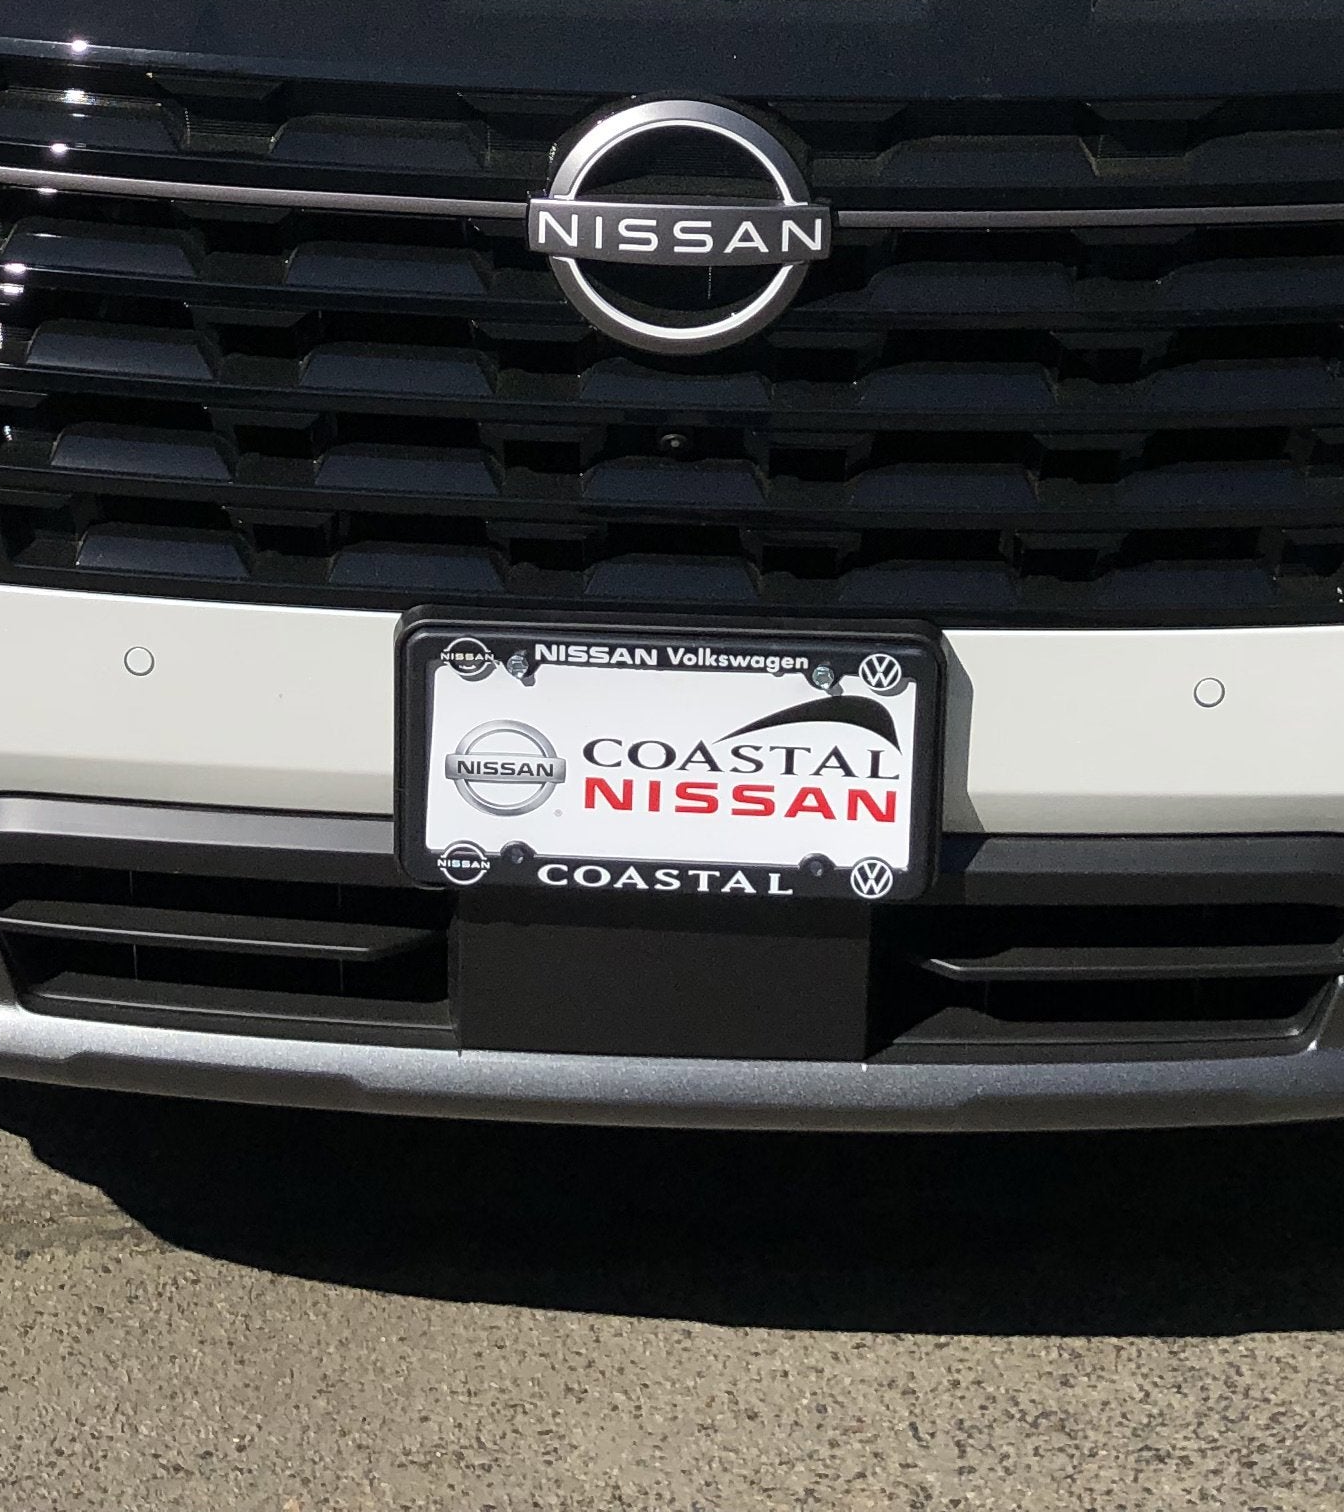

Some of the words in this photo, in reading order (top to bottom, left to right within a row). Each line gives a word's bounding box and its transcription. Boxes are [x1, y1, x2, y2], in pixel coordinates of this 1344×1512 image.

[538, 210, 822, 253] NISSAN
[440, 652, 495, 661] NISSAN
[535, 643, 658, 666] NISSAN
[667, 647, 809, 672] Volkswagen
[457, 760, 554, 777] NISSAN
[582, 738, 900, 780] COASTAL
[584, 776, 897, 823] NISSAN
[437, 859, 490, 869] NISSAN
[537, 863, 793, 895] COASTAL
